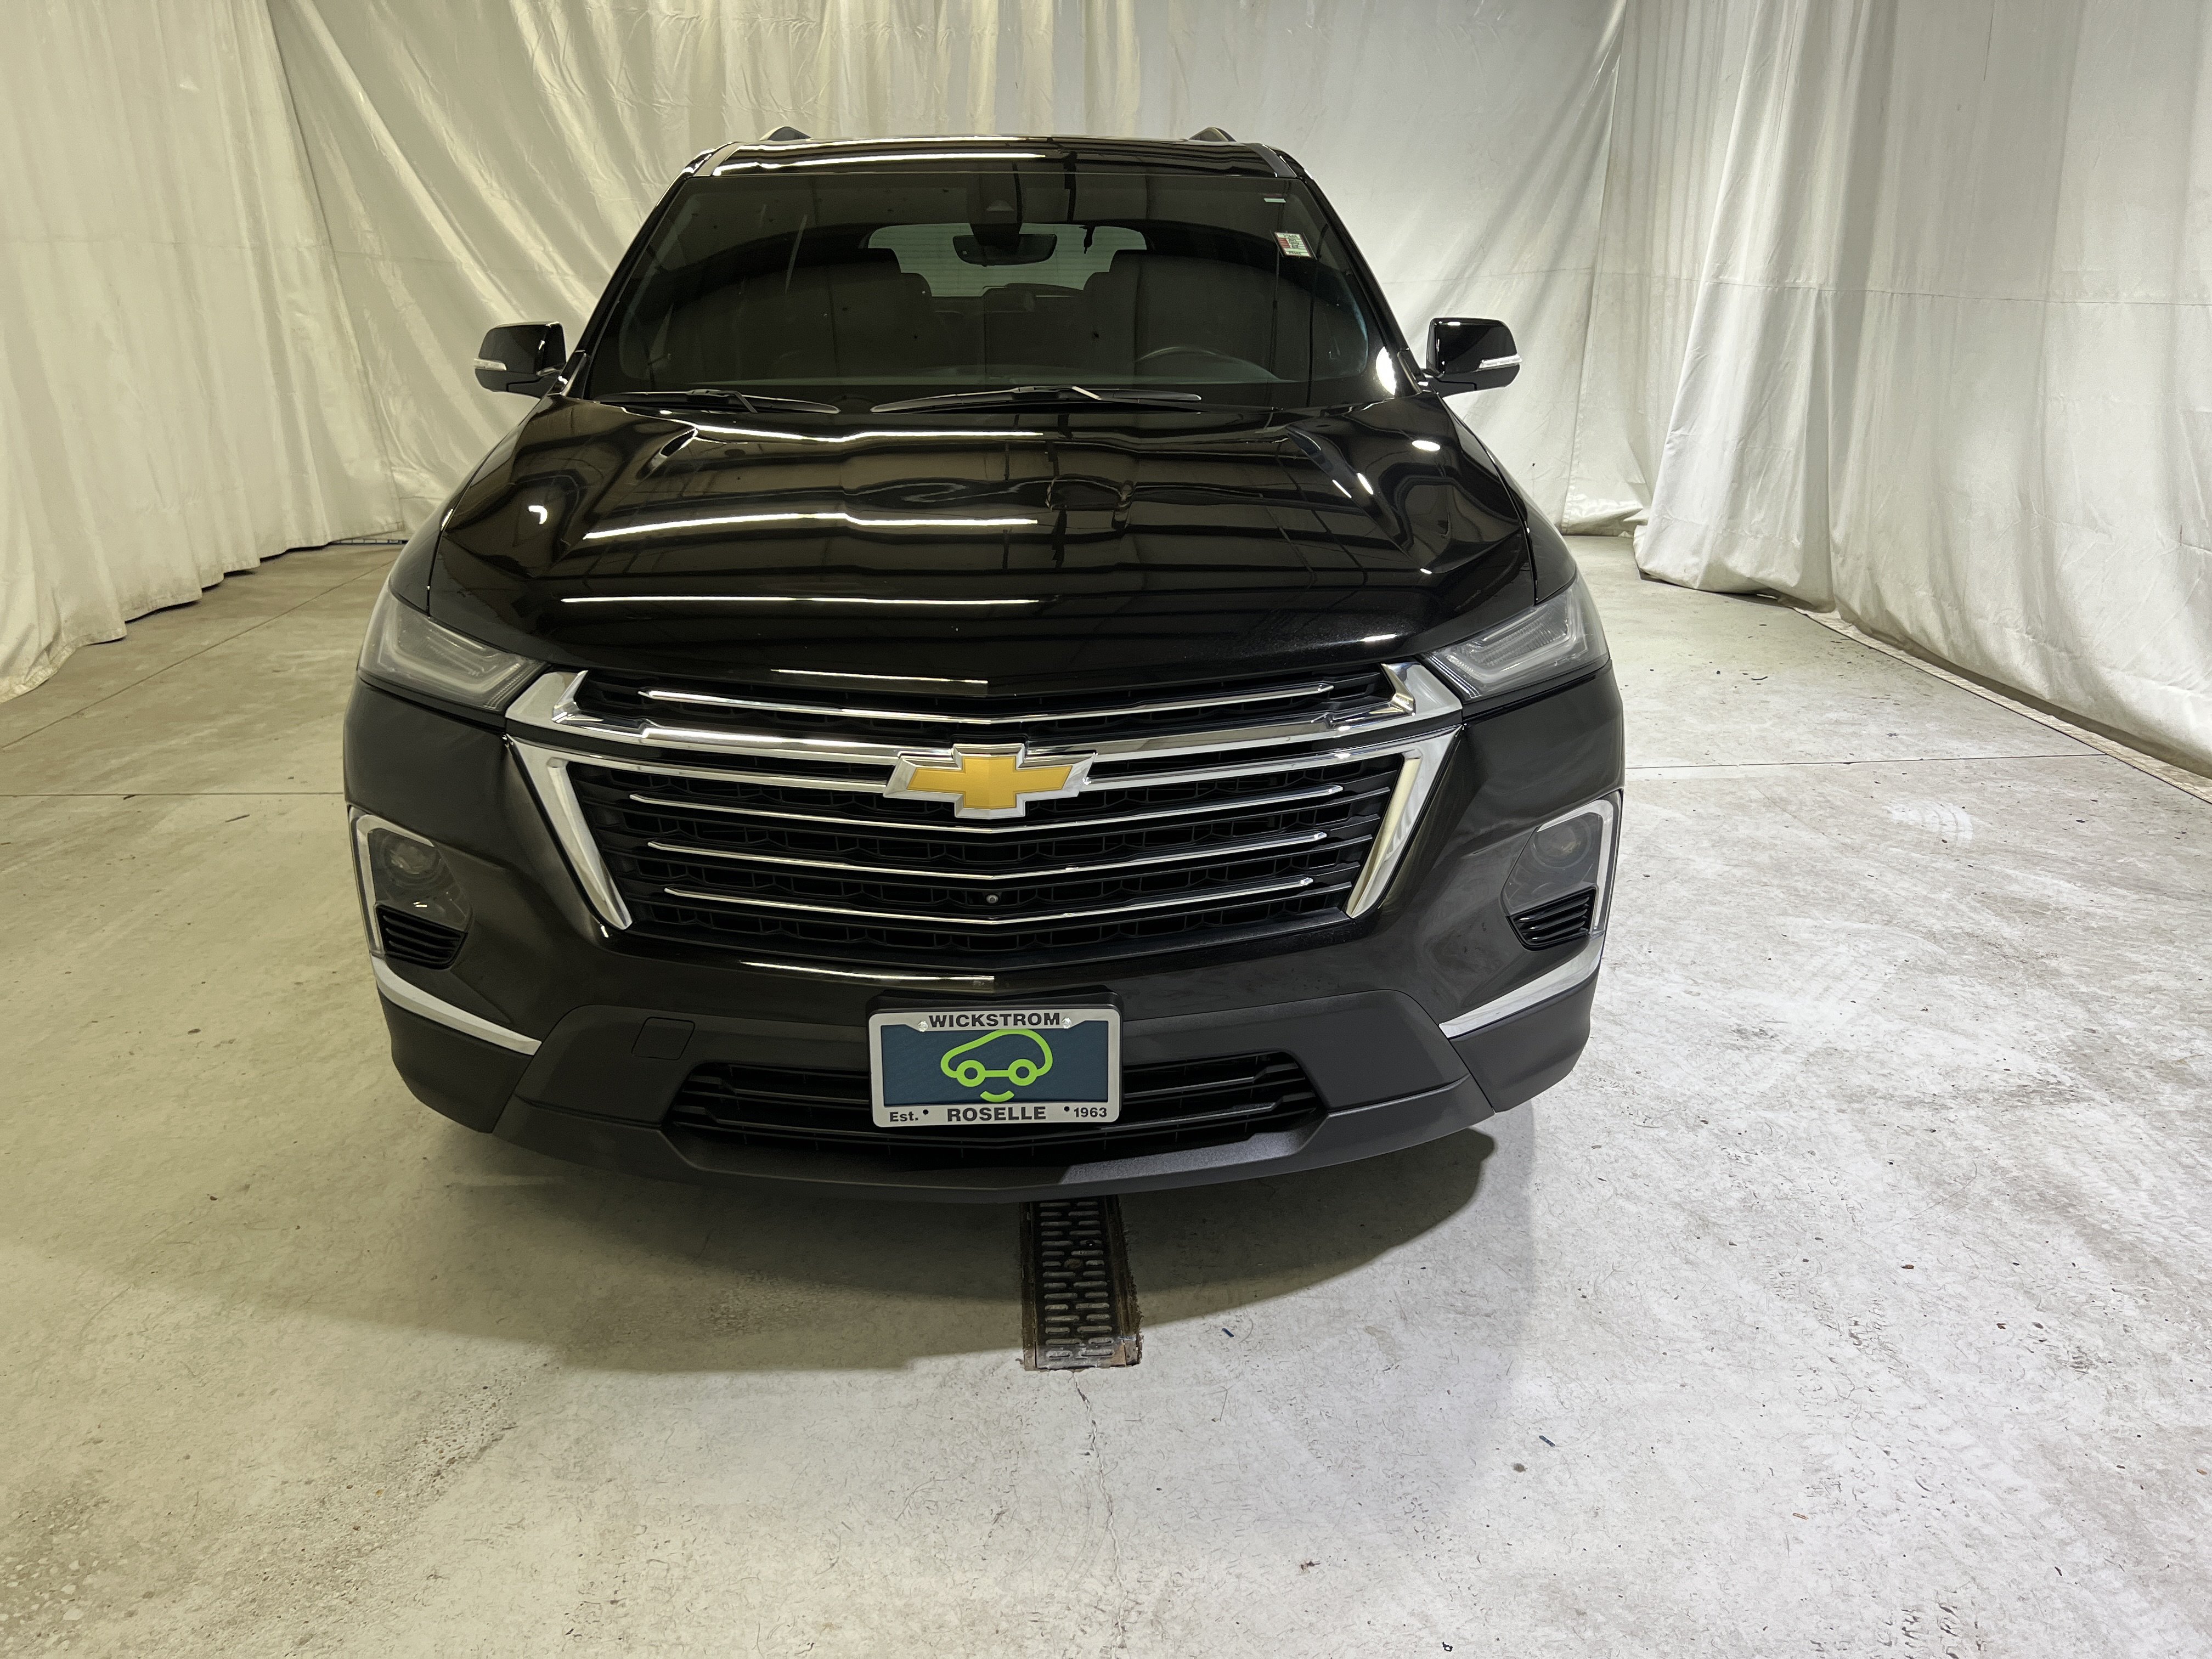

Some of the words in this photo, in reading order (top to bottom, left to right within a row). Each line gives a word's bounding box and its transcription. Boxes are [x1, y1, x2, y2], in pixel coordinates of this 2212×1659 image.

[928, 1012, 1060, 1028] WICKSTROM
[889, 1111, 919, 1122] Est.
[947, 1106, 1046, 1122] ROSELLE
[1074, 1107, 1107, 1118] 1963
